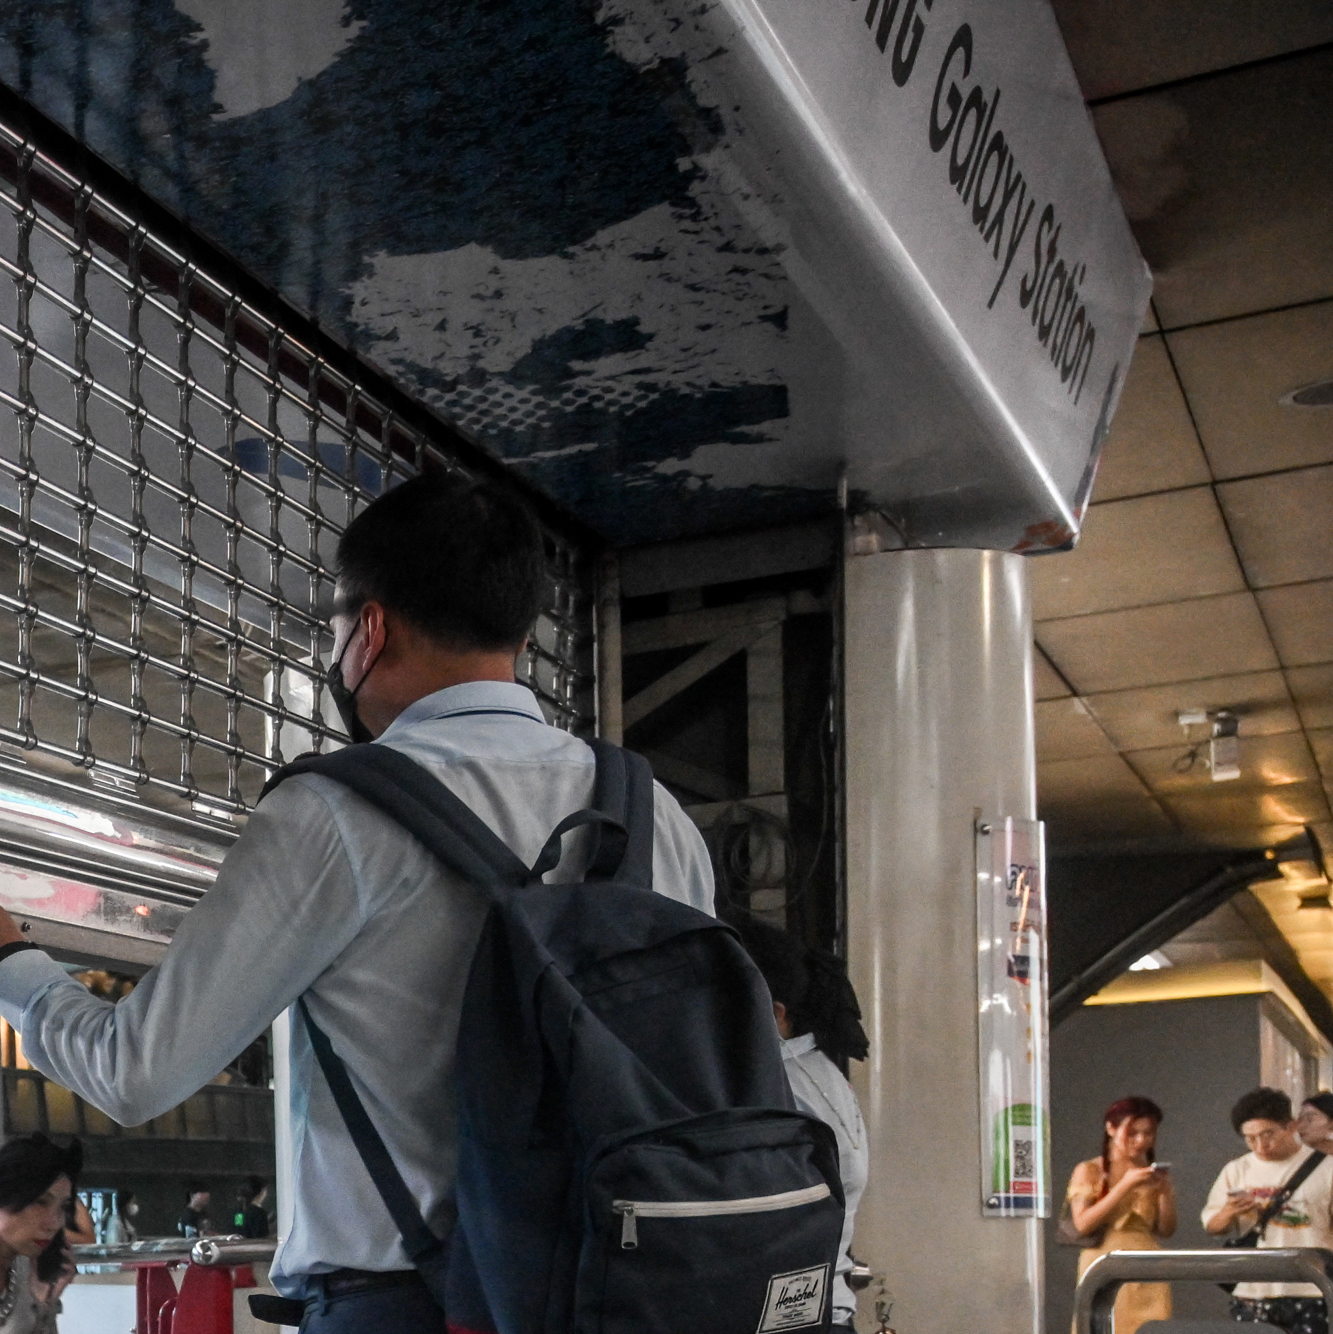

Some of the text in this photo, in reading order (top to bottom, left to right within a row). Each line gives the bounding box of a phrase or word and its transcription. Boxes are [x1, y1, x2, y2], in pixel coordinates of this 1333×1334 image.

[929, 23, 1035, 310] Galaxy
[1020, 203, 1096, 406] Station
[775, 1279, 817, 1310] Herschel
